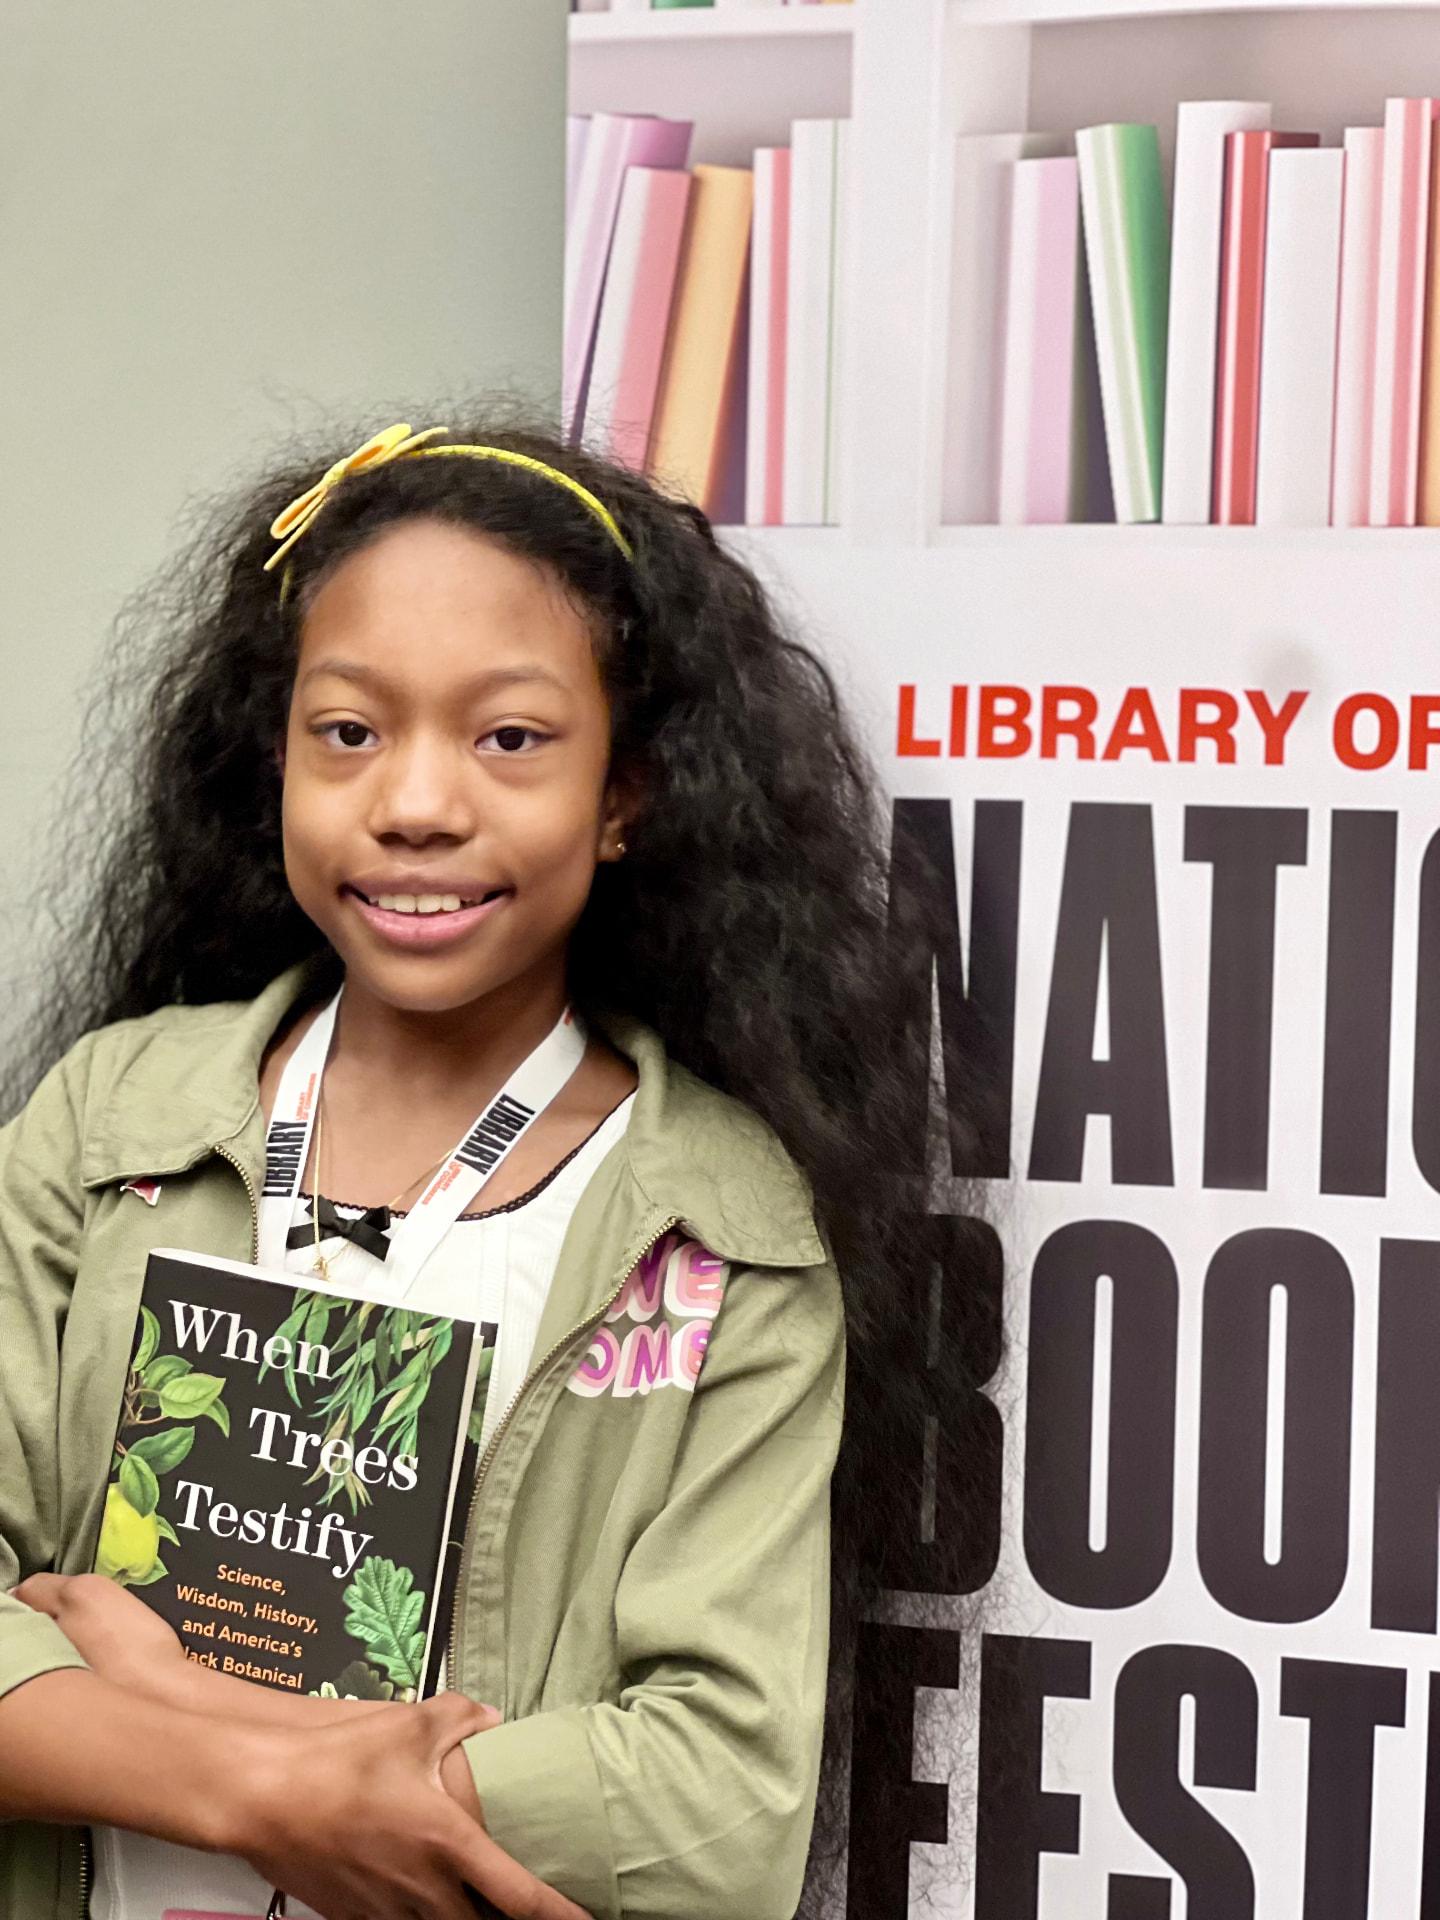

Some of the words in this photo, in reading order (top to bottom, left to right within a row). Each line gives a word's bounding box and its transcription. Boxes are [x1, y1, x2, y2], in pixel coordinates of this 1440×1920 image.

[896, 684, 1310, 766] LIBRARY
[885, 797, 1440, 1199] NATI
[261, 1121, 308, 1197] LIBRARY
[454, 1092, 536, 1175] LIBRARY
[168, 1300, 331, 1380] When
[249, 1407, 418, 1490] Trees
[174, 1480, 374, 1578] Testify
[176, 1583, 248, 1618] Wisdom,
[254, 1602, 319, 1634] History,
[216, 1564, 287, 1596] Science,
[182, 1619, 215, 1638] and
[218, 1625, 303, 1658] America's
[184, 1645, 218, 1669] lack
[222, 1656, 303, 1689] Botanical
[847, 1621, 1440, 1920] FEST
